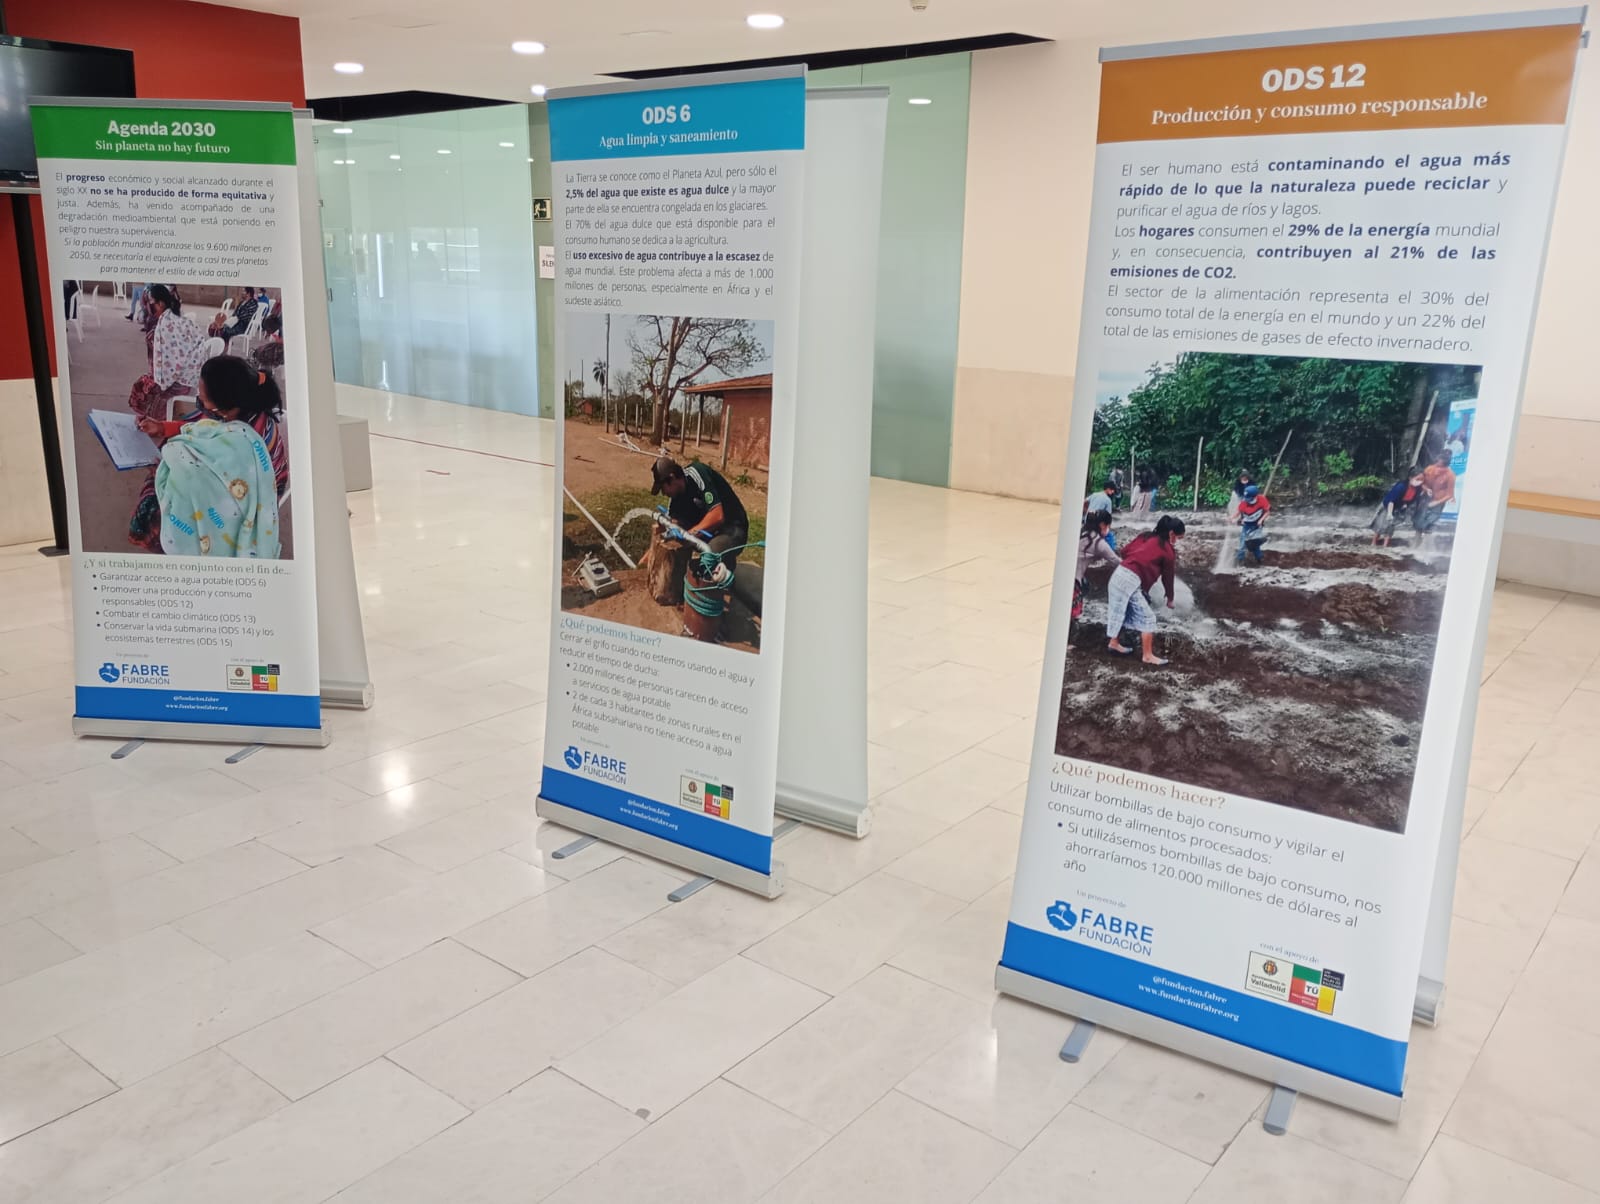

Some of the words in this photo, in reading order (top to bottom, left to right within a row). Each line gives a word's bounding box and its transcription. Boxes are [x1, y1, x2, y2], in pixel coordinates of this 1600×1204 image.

[1261, 65, 1324, 92] ODS
[1329, 63, 1366, 88] 12
[641, 105, 676, 125] ODS
[679, 104, 691, 122] 6
[1151, 104, 1251, 124] Producción
[1254, 107, 1267, 123] y
[1270, 102, 1356, 118] consumo
[1360, 91, 1487, 116] responsable
[107, 119, 168, 137] Agenda
[171, 121, 215, 136] 2030
[599, 135, 624, 149] Agua
[626, 131, 658, 148] limpia
[660, 134, 667, 146] y
[669, 128, 738, 143] saneamiento
[95, 139, 112, 150] Sin
[115, 140, 155, 152] planeta
[157, 143, 171, 151] no
[173, 141, 192, 154] hay
[194, 142, 230, 153] futuro
[1121, 163, 1132, 176] El
[1140, 165, 1160, 176] ser
[1167, 162, 1222, 174] humano
[1231, 159, 1258, 173] está
[1268, 155, 1384, 171] contaminando
[1394, 153, 1410, 168] el
[1420, 156, 1461, 171] agua
[1473, 151, 1511, 166] más
[1119, 183, 1163, 199] rápido
[1170, 182, 1187, 195] de
[1194, 182, 1207, 195] lo
[1215, 184, 1242, 198] que
[1249, 180, 1262, 193] la
[1270, 179, 1355, 193] naturaleza
[1364, 177, 1415, 195] puede
[1424, 175, 1490, 190] reciclar
[1497, 179, 1508, 193] y
[1114, 225, 1135, 237] Los
[1138, 224, 1194, 240] hogares
[1198, 226, 1268, 237] consumen
[1272, 223, 1284, 237] el
[1287, 223, 1320, 236] 29%
[1324, 223, 1344, 236] de
[1348, 223, 1362, 236] la
[1367, 222, 1430, 239] energía
[1435, 222, 1500, 236] mundial
[1110, 265, 1178, 277] emisiones
[1182, 265, 1200, 278] de
[1204, 266, 1236, 278] CO2.
[121, 663, 169, 676] FABRE
[121, 675, 170, 685] FUNDACIÓN
[584, 750, 626, 775] FABRE
[1051, 761, 1092, 777] ¿Qué
[1095, 770, 1166, 796] podemos
[1170, 784, 1225, 809] hacer?
[1047, 800, 1103, 821] consumo
[1106, 812, 1122, 826] de
[1125, 818, 1186, 843] alimentos
[1189, 836, 1272, 864] procesados:
[1050, 780, 1091, 800] Utilizar
[1094, 790, 1153, 815] bombillas
[1156, 807, 1173, 820] de
[1176, 810, 1205, 829] bajo
[1208, 820, 1271, 844] consumo
[1274, 836, 1283, 849] y
[1286, 839, 1327, 857] vigilar
[1331, 850, 1344, 862] el
[1063, 859, 1086, 872] año
[1080, 908, 1153, 943] FABRE
[1078, 926, 1151, 956] FUNDACIÓN
